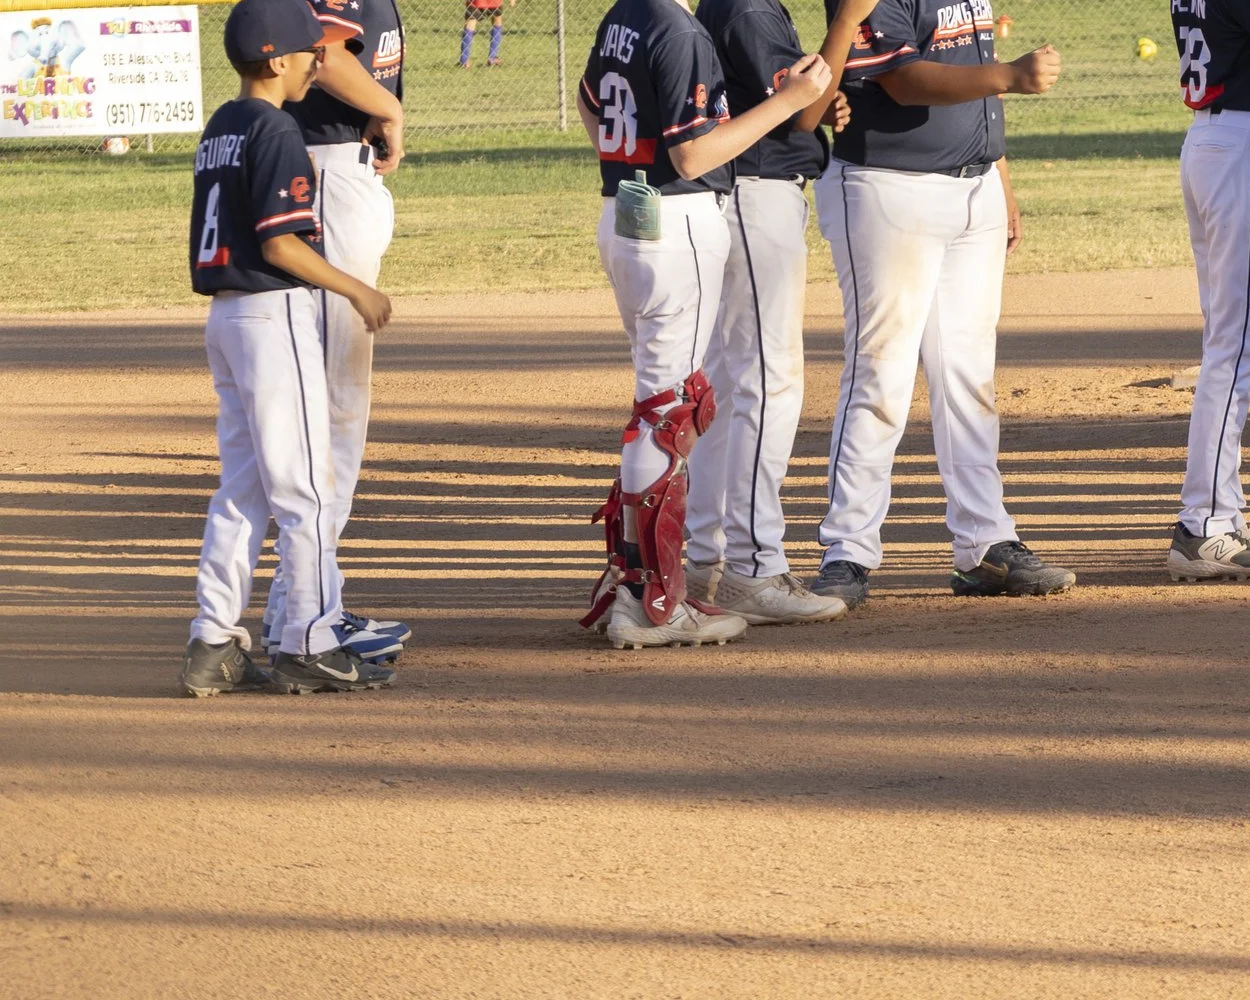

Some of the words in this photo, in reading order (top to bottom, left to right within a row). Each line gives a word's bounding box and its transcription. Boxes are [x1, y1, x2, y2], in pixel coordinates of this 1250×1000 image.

[17, 75, 96, 97] LEARNING
[3, 99, 93, 126] EXPERIENCE
[106, 103, 136, 126] (951)
[140, 101, 195, 124] 776-2459
